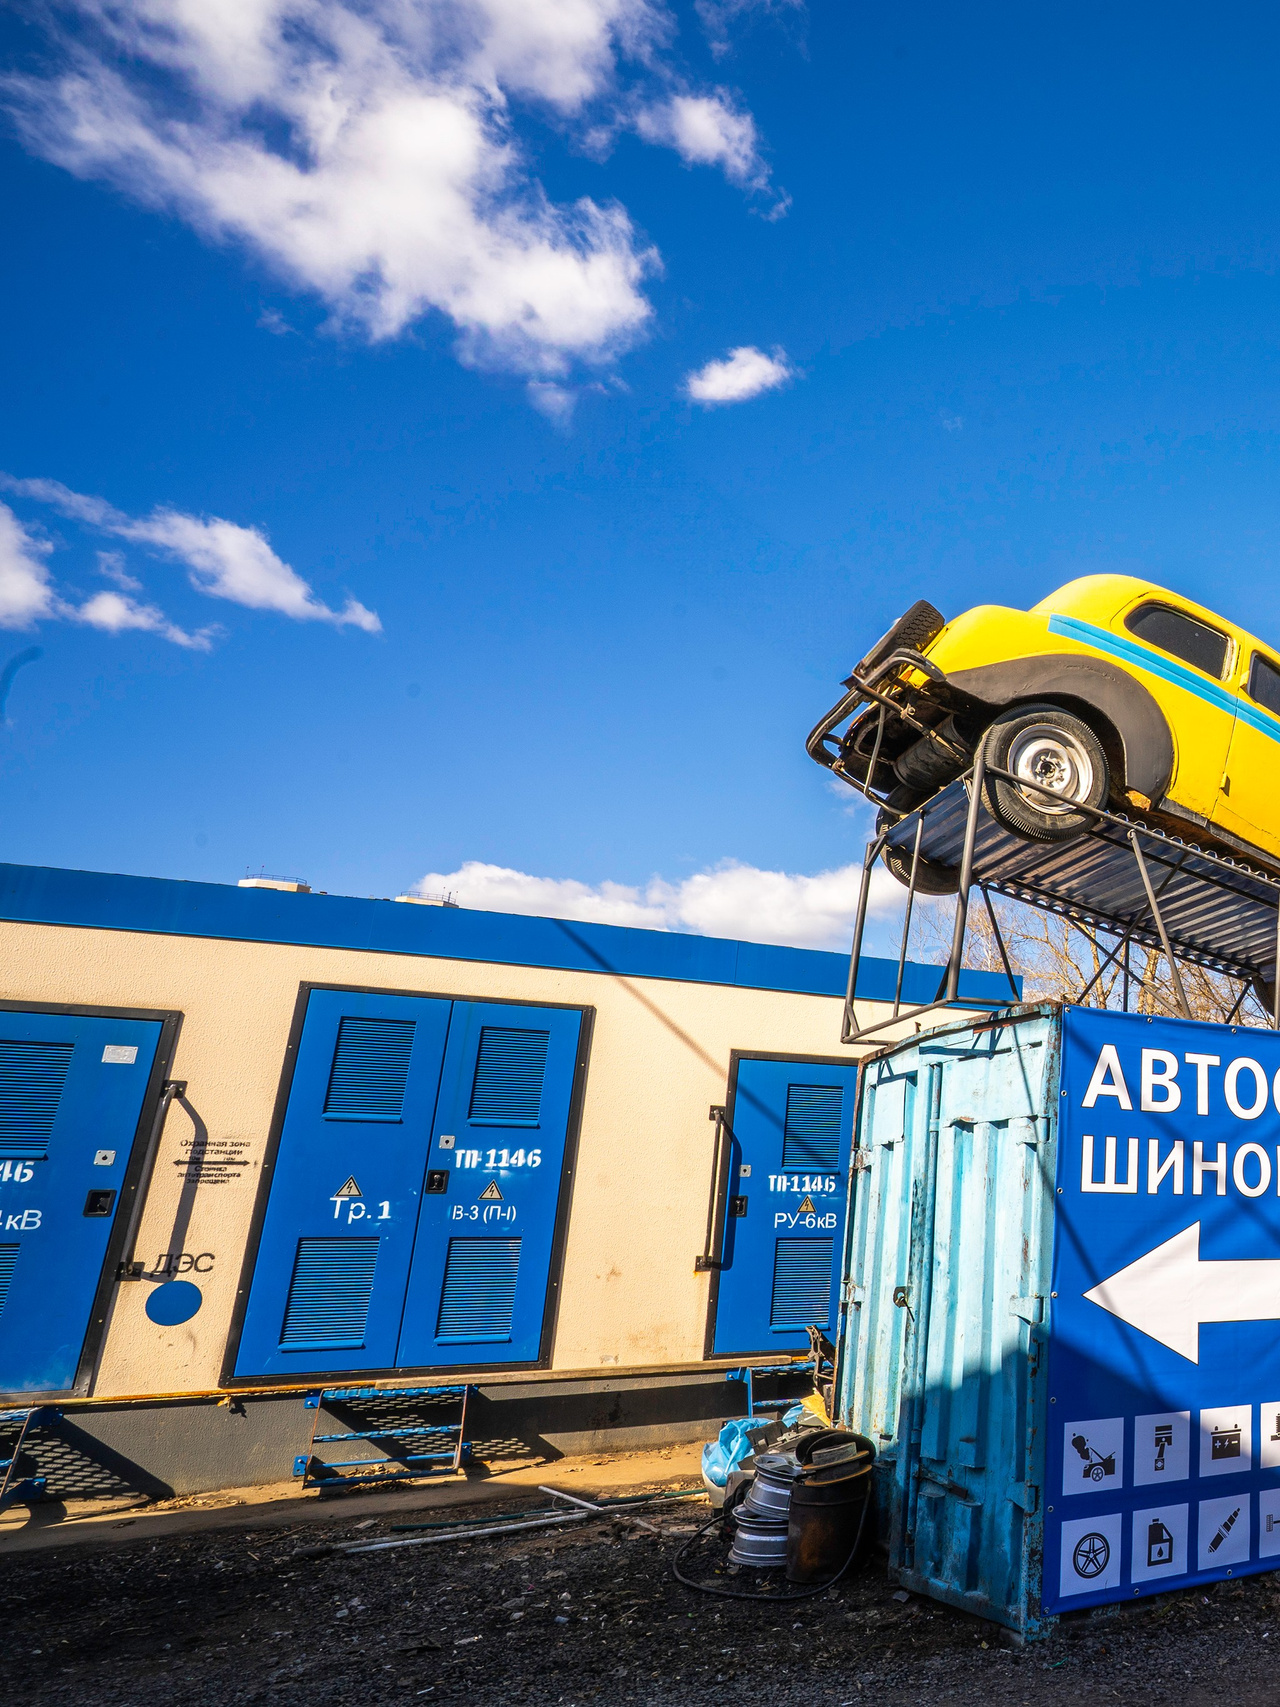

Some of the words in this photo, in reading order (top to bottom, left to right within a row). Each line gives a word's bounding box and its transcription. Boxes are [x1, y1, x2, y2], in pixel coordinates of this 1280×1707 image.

[180, 1139, 228, 1148] Охранная
[455, 1148, 542, 1168] ТП-1146
[768, 1175, 836, 1193] ТП-1146
[774, 1212, 837, 1229] РУ-6кВ
[149, 1252, 216, 1277] ДЭС
